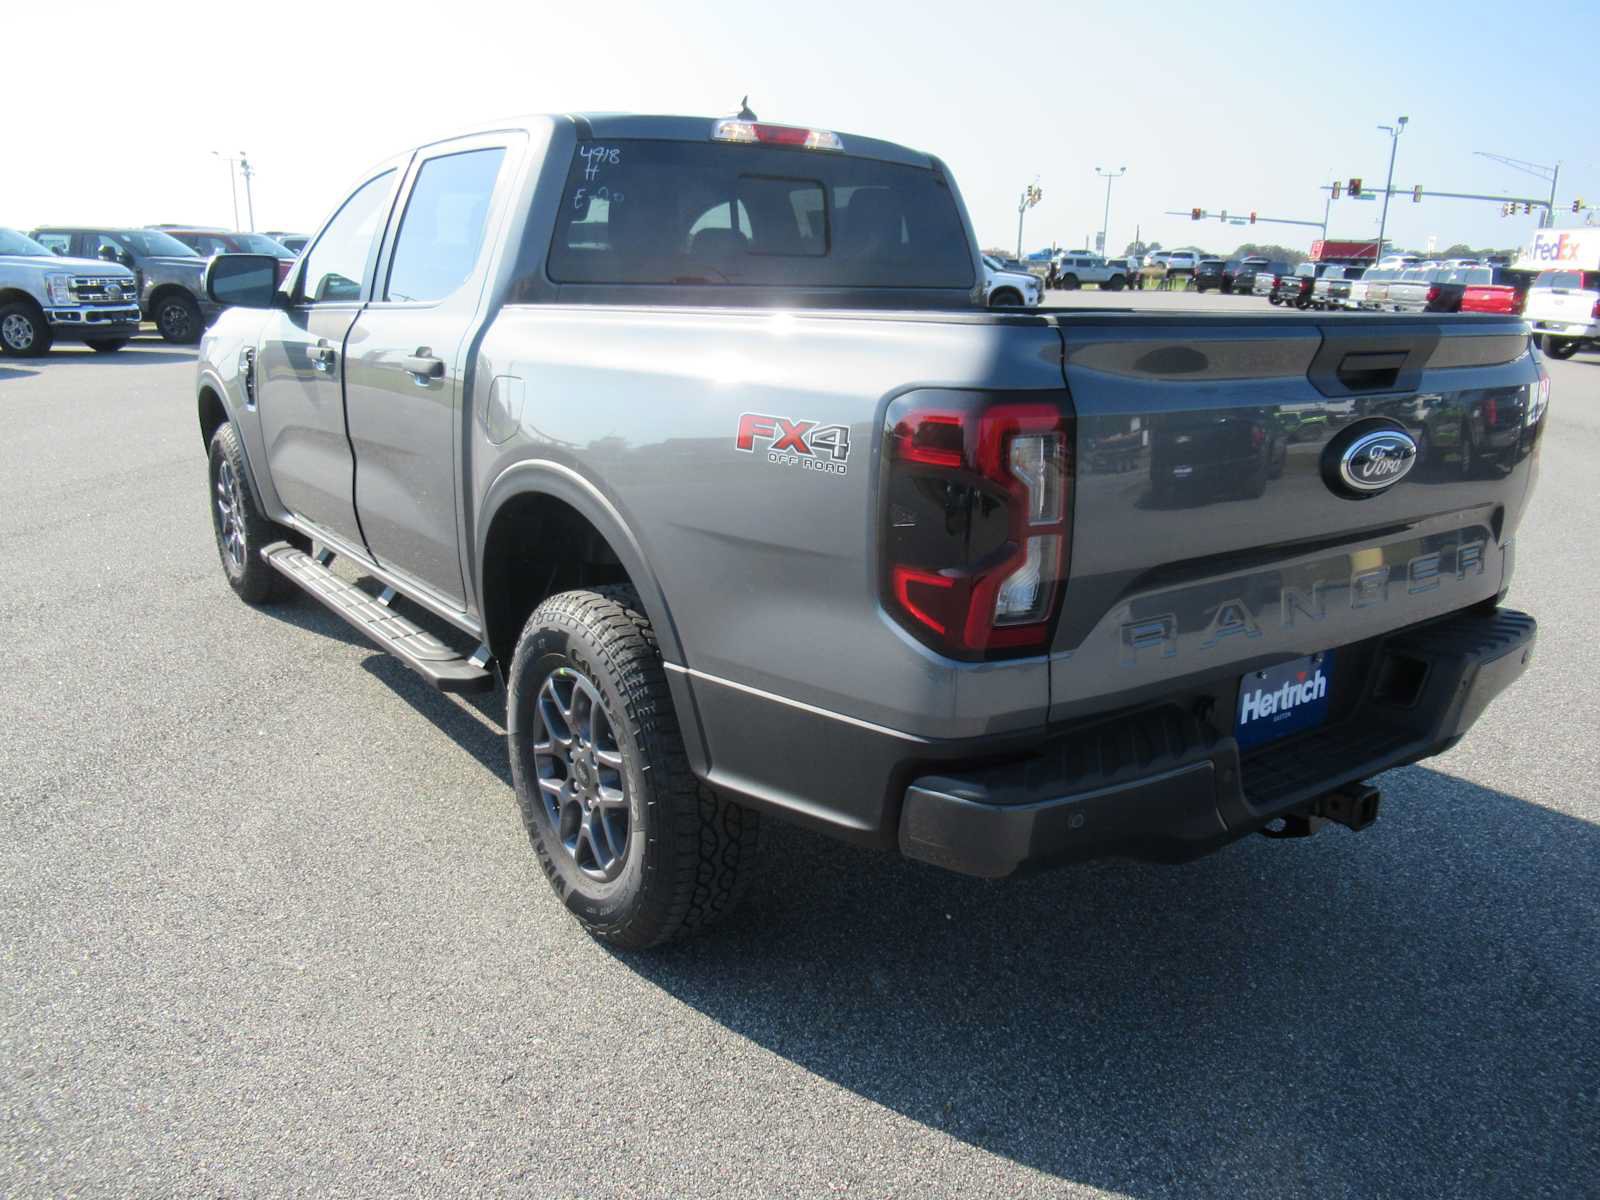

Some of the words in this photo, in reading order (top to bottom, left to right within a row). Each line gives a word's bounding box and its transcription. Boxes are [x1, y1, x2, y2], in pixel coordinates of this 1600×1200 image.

[1533, 234, 1580, 261] FedEx
[736, 411, 850, 462] FX4
[768, 452, 799, 465] OFF
[803, 459, 847, 475] ROAD
[1362, 444, 1406, 477] Ford
[1120, 539, 1486, 668] RANGER
[1240, 669, 1327, 725] Hertrich
